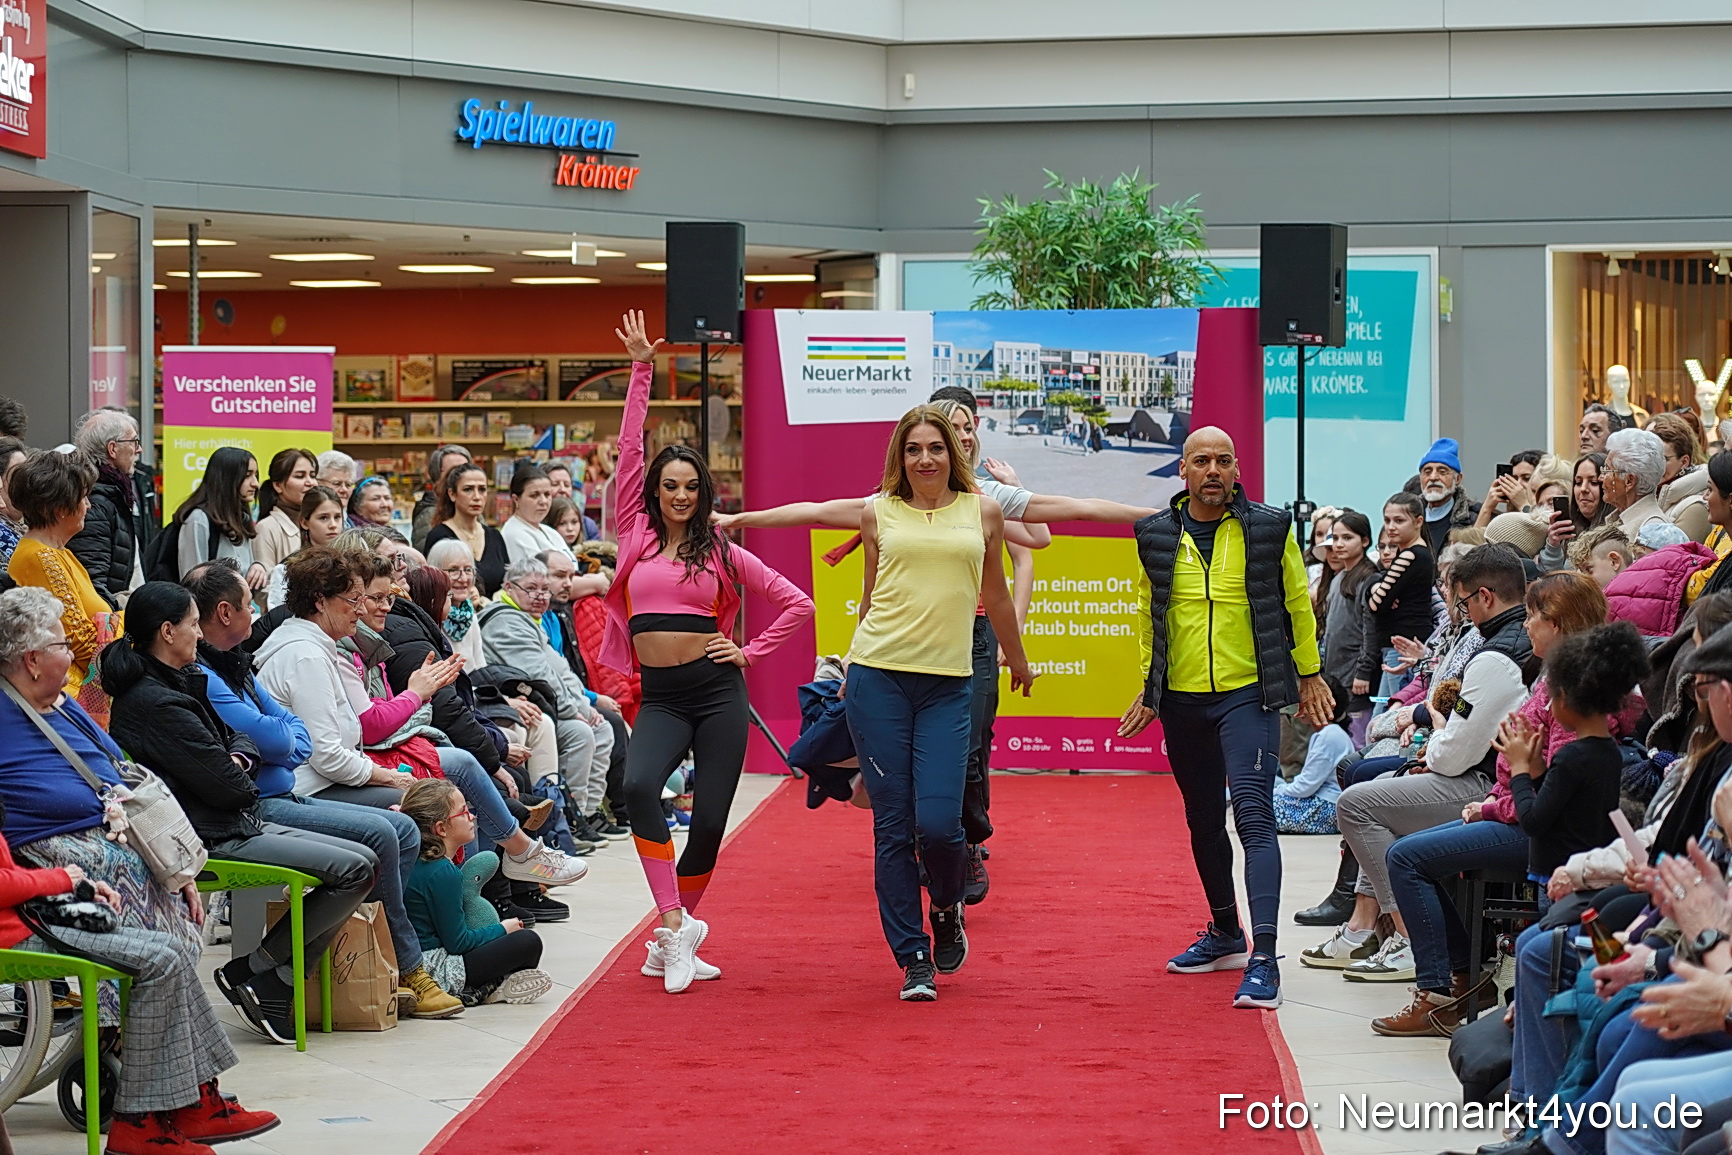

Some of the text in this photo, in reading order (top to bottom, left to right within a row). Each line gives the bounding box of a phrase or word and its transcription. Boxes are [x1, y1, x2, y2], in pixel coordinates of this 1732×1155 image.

[457, 97, 617, 150] Spielwaren
[555, 153, 641, 191] Krömer
[1319, 350, 1364, 367] NEBENAN
[1367, 350, 1383, 367] BEI
[802, 365, 912, 381] NeuerMarkt
[173, 375, 316, 393] Verschenken Sie
[211, 396, 316, 414] Gutscheine!
[174, 438, 197, 449] Hier
[1051, 576, 1103, 593] einem
[1106, 577, 1133, 593] Ort
[1027, 598, 1081, 615] orkout
[1023, 620, 1135, 637] rlaub buchen.
